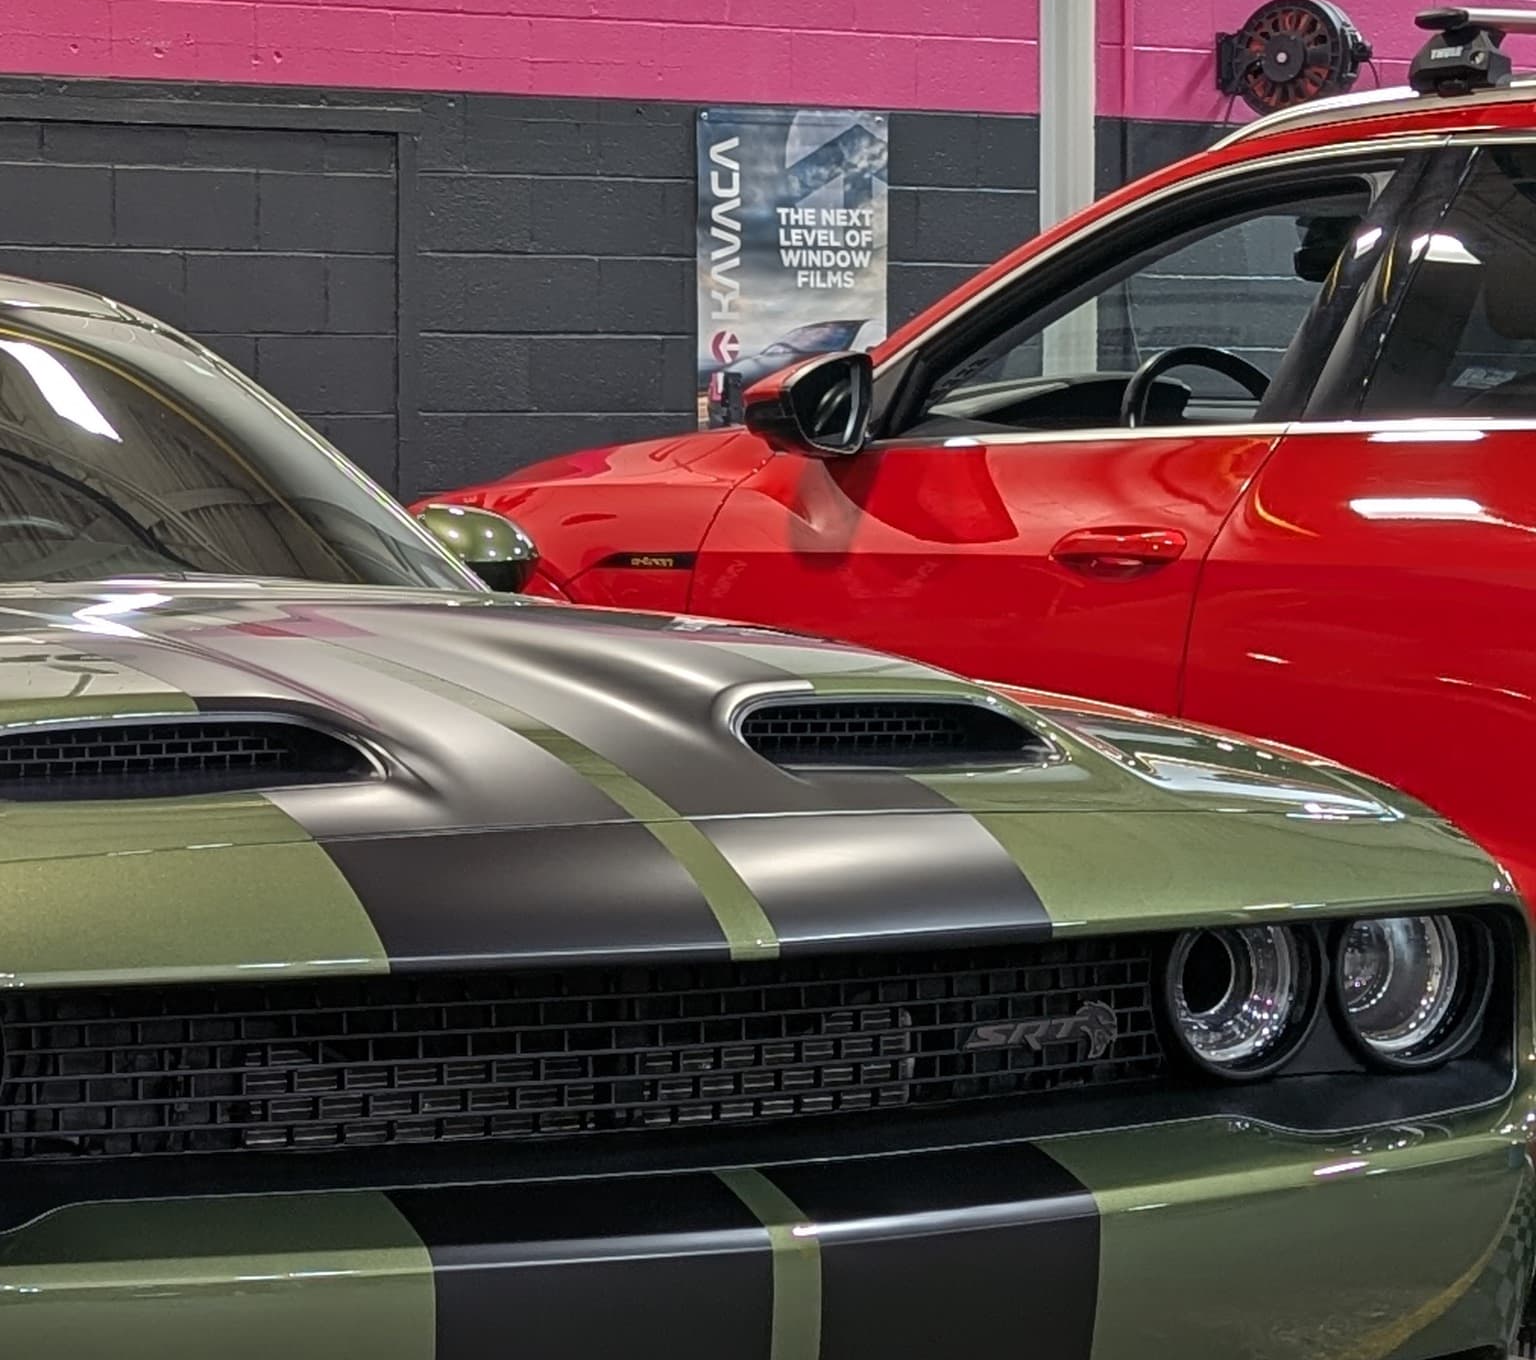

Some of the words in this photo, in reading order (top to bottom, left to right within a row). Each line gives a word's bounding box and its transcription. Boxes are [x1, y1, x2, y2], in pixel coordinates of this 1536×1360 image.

[776, 207, 816, 226] THE
[820, 208, 874, 227] NEXT
[709, 135, 742, 321] KAVACA
[779, 228, 841, 248] LEVEL
[844, 229, 874, 248] OF
[780, 249, 872, 269] WINDOW
[796, 270, 856, 289] FILMS
[966, 1015, 1090, 1051] SRT
